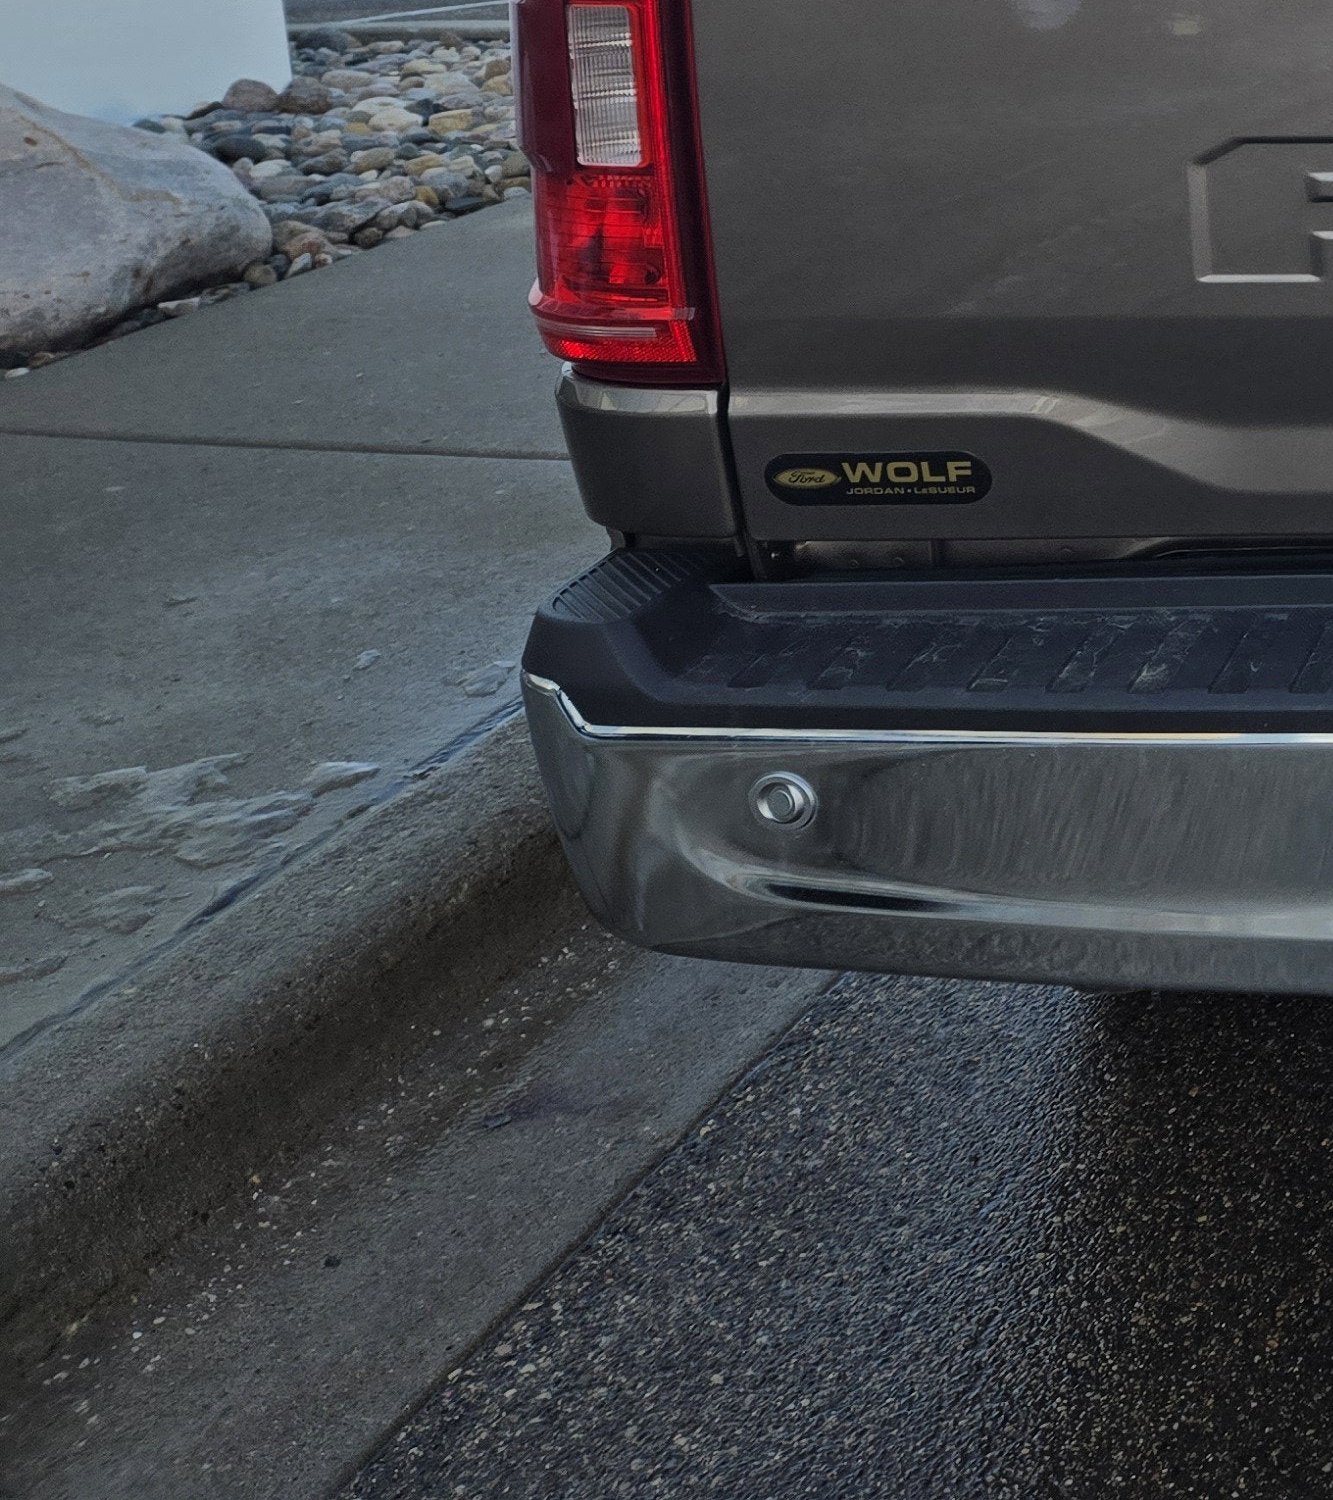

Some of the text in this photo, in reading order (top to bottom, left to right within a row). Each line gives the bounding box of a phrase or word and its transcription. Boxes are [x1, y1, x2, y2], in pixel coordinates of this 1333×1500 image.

[788, 470, 826, 483] Ford
[841, 461, 972, 483] WOLF
[846, 486, 905, 495] JORDAN
